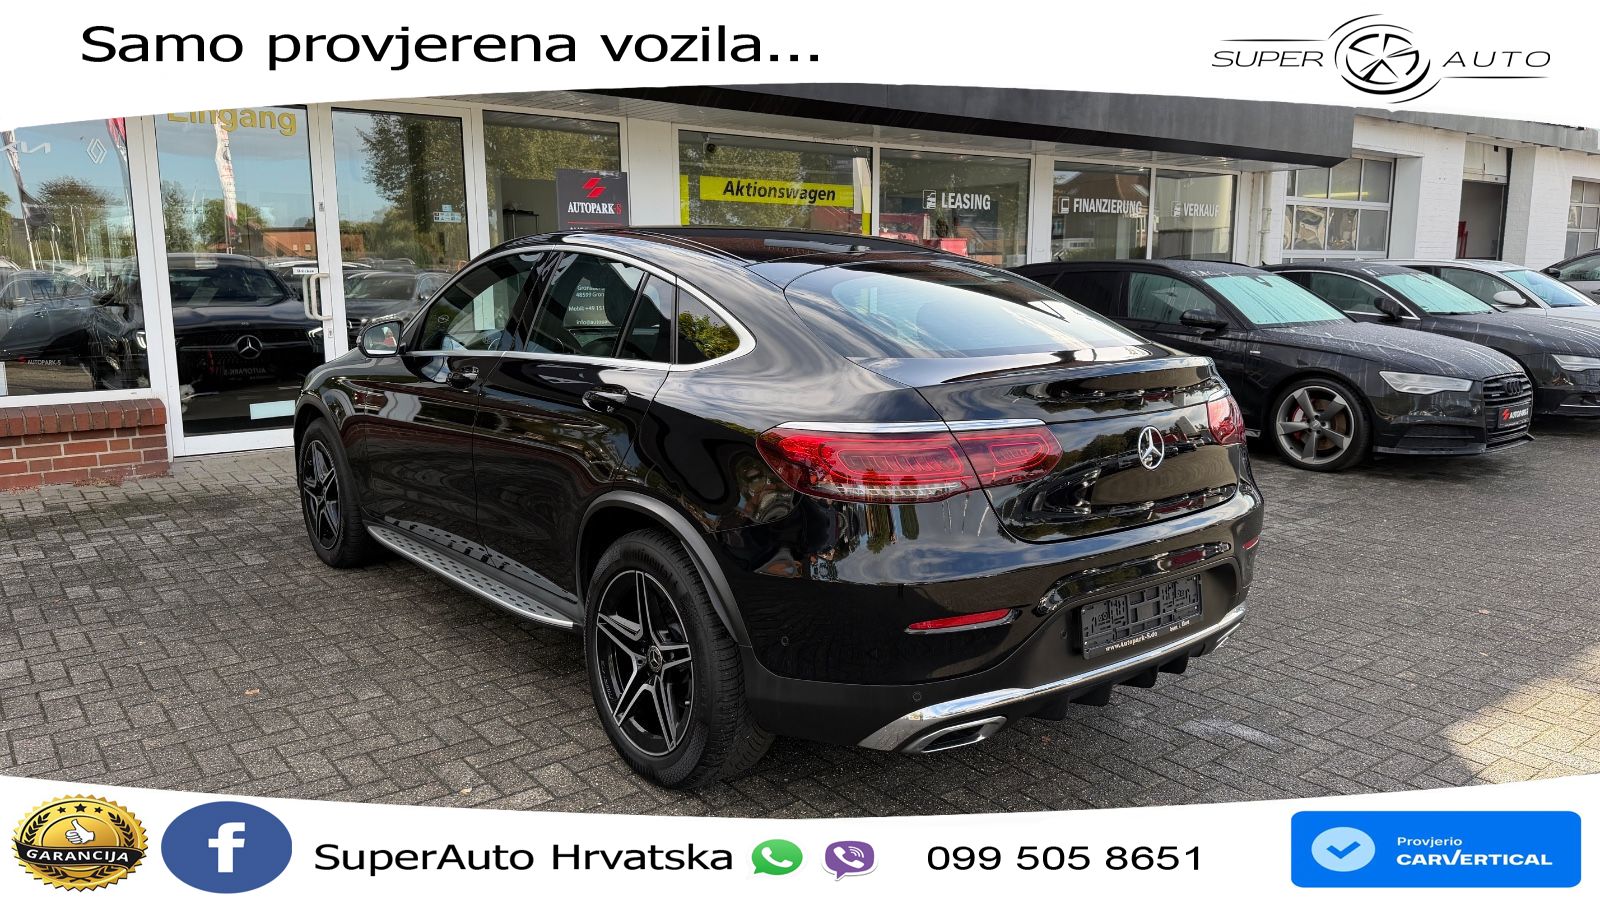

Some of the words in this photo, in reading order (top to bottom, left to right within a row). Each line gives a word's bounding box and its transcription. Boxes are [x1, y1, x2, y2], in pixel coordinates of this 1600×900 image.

[722, 179, 836, 204] Aktionswagen
[941, 192, 991, 211] LEASING
[1073, 198, 1143, 215] FINANZIERUNG
[1183, 203, 1220, 218] VERKAUF
